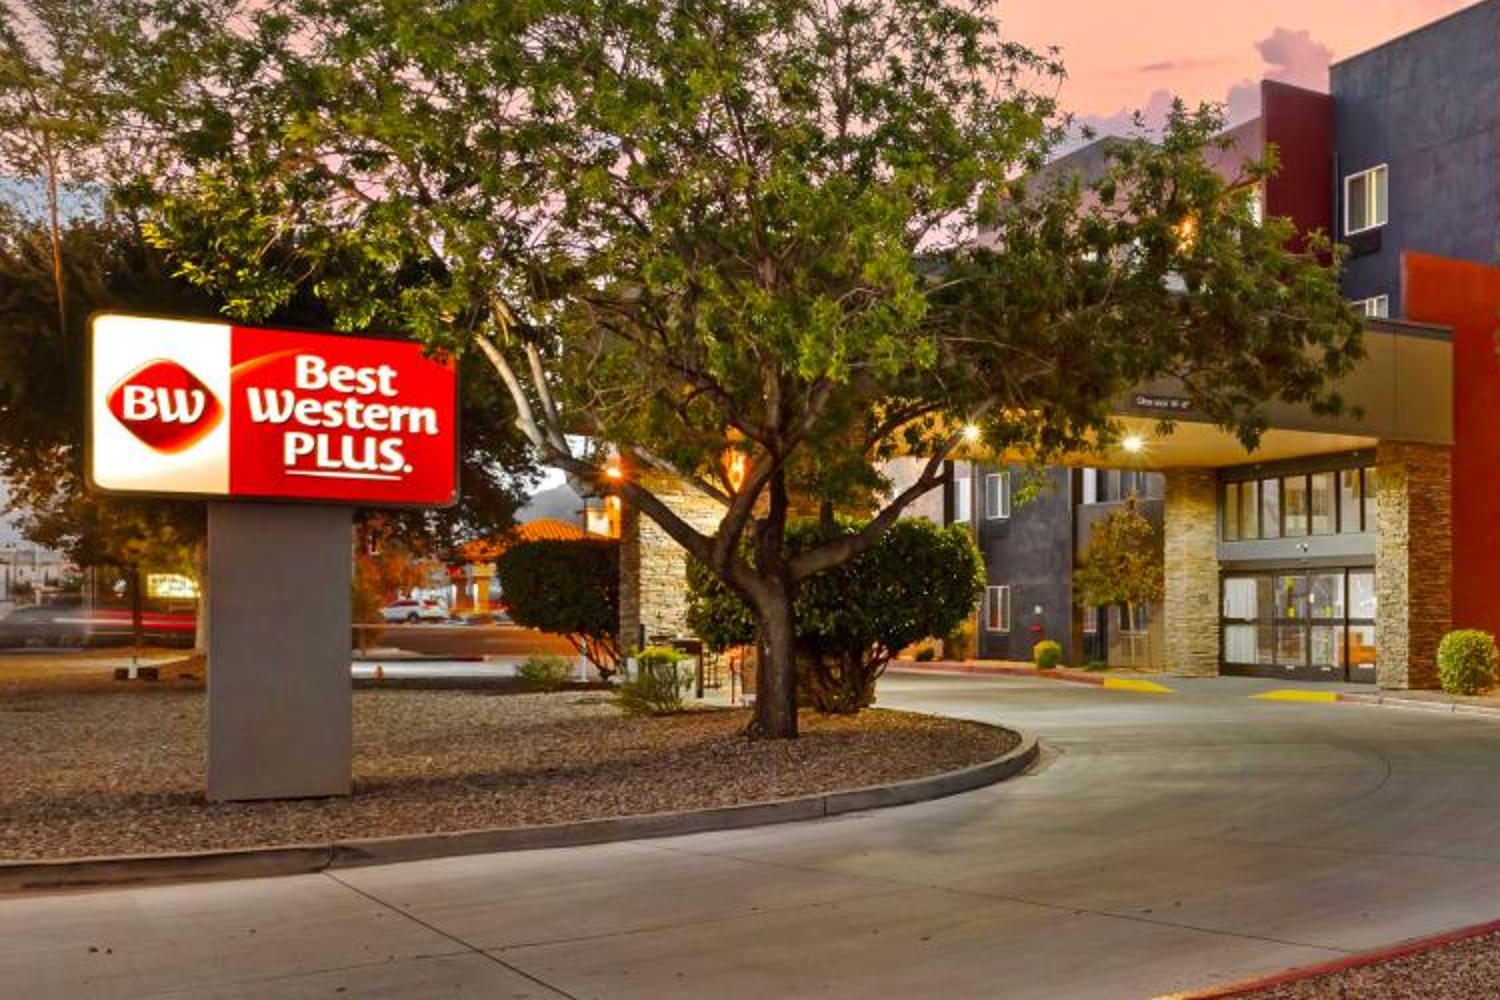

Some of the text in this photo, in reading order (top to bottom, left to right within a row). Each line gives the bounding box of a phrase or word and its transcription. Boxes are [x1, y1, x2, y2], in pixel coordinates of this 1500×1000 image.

[296, 355, 398, 396] Best
[122, 385, 206, 424] BW
[248, 387, 439, 434] Western
